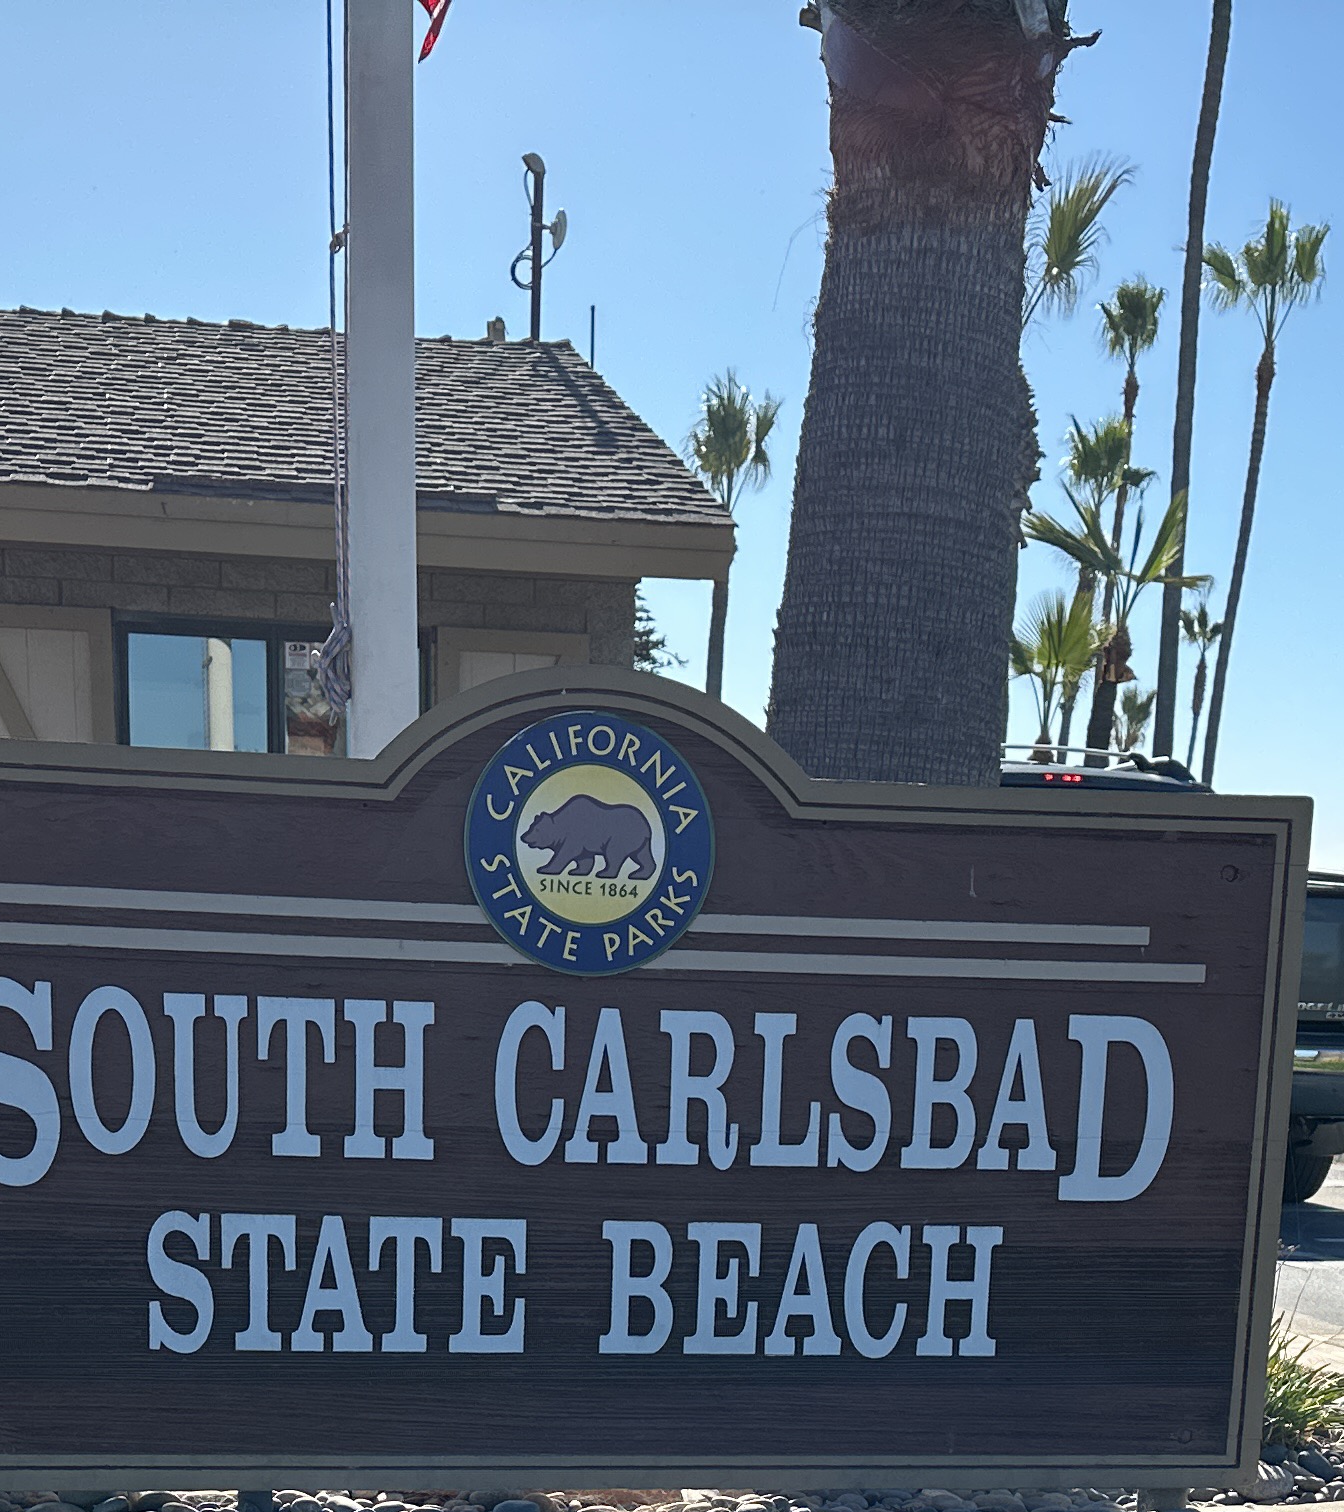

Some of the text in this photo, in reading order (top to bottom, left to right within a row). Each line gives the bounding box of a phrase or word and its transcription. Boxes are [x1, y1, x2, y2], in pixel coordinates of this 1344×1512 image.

[487, 725, 699, 834] CALIFORNIA
[481, 853, 699, 962] STATE PARKS
[539, 877, 639, 899] SINCE 1864
[494, 1000, 1174, 1202] CARLSBAD
[147, 1210, 1004, 1359] STATE BEACH
